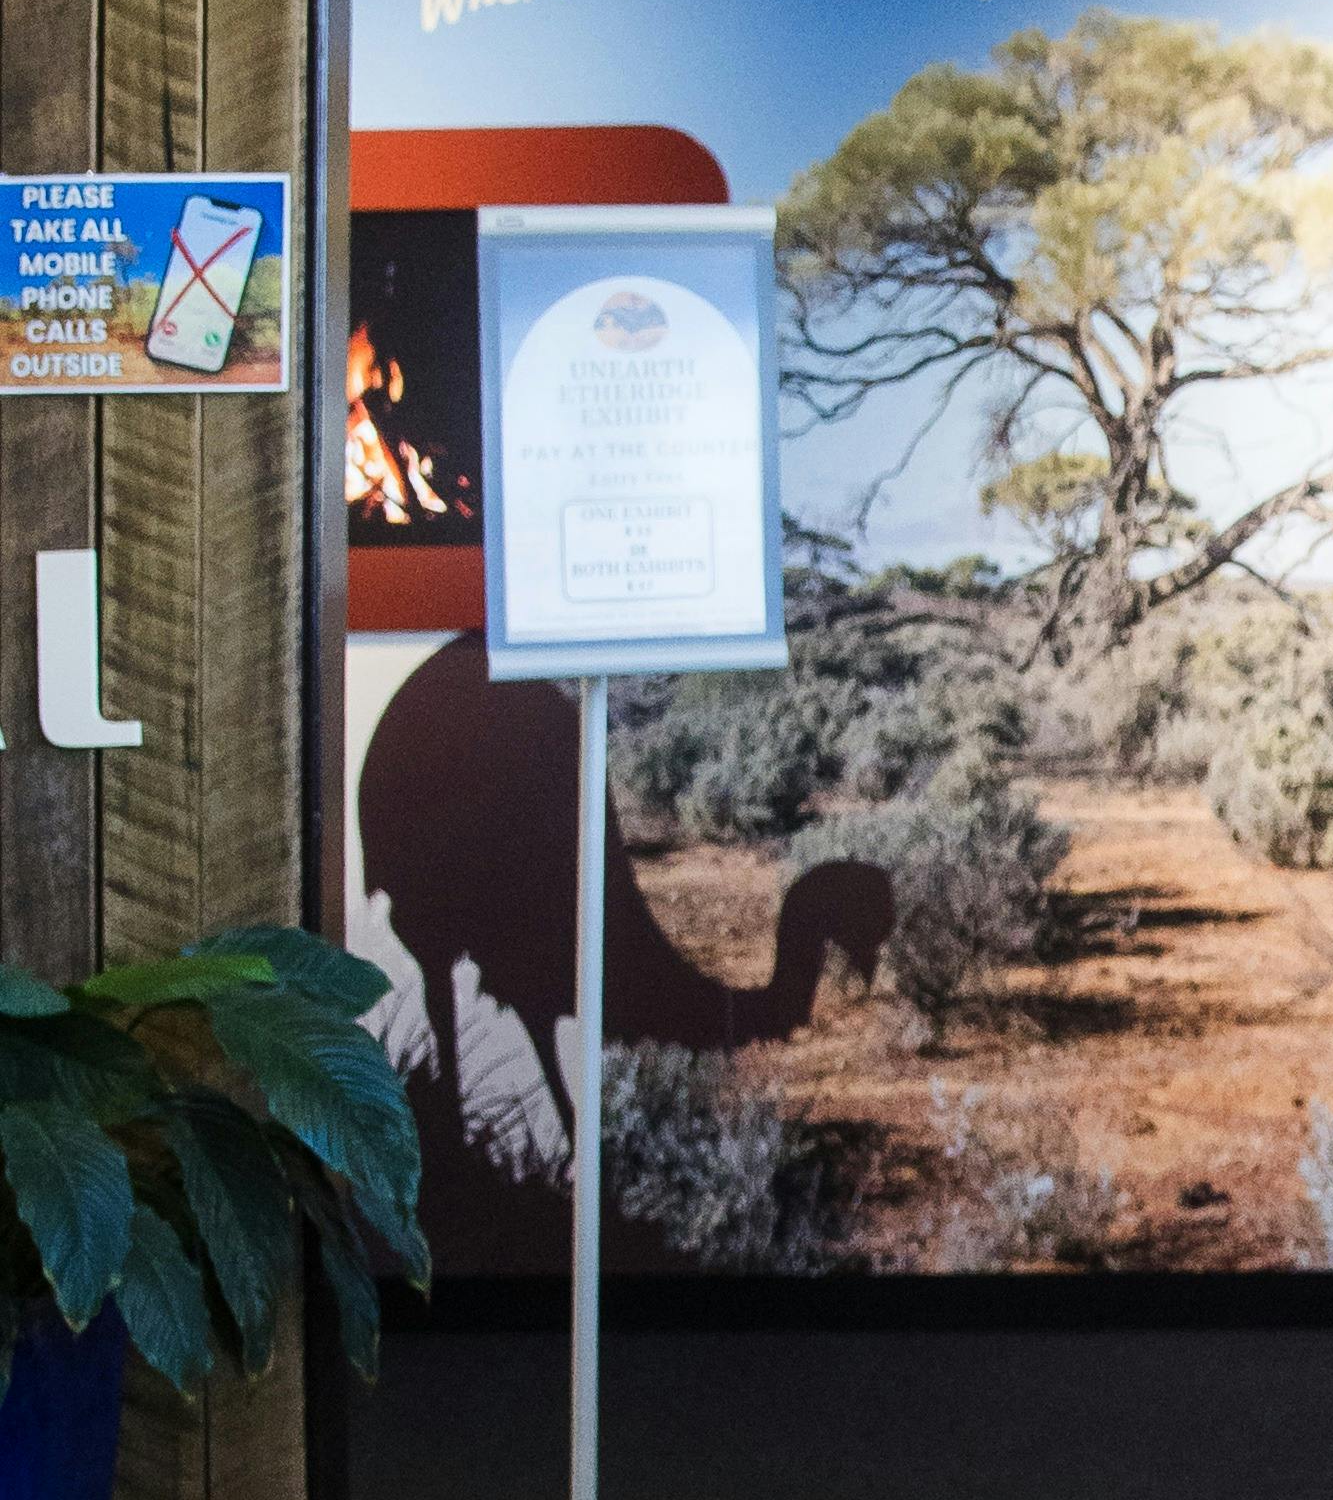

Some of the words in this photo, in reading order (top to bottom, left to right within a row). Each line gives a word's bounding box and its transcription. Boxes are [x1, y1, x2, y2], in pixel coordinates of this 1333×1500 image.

[22, 185, 114, 209] PLEASE
[10, 218, 76, 243] TAKE
[80, 217, 126, 242] ALL
[19, 252, 117, 277] MOBILE
[21, 285, 112, 311] PHONE
[25, 319, 108, 343] CALLS
[10, 353, 124, 378] OUTSIDE
[570, 359, 696, 380] UNEARTH
[580, 404, 687, 427] EXHIBIT
[521, 445, 559, 461] PAY
[572, 444, 597, 458] AT
[610, 442, 646, 457] THE
